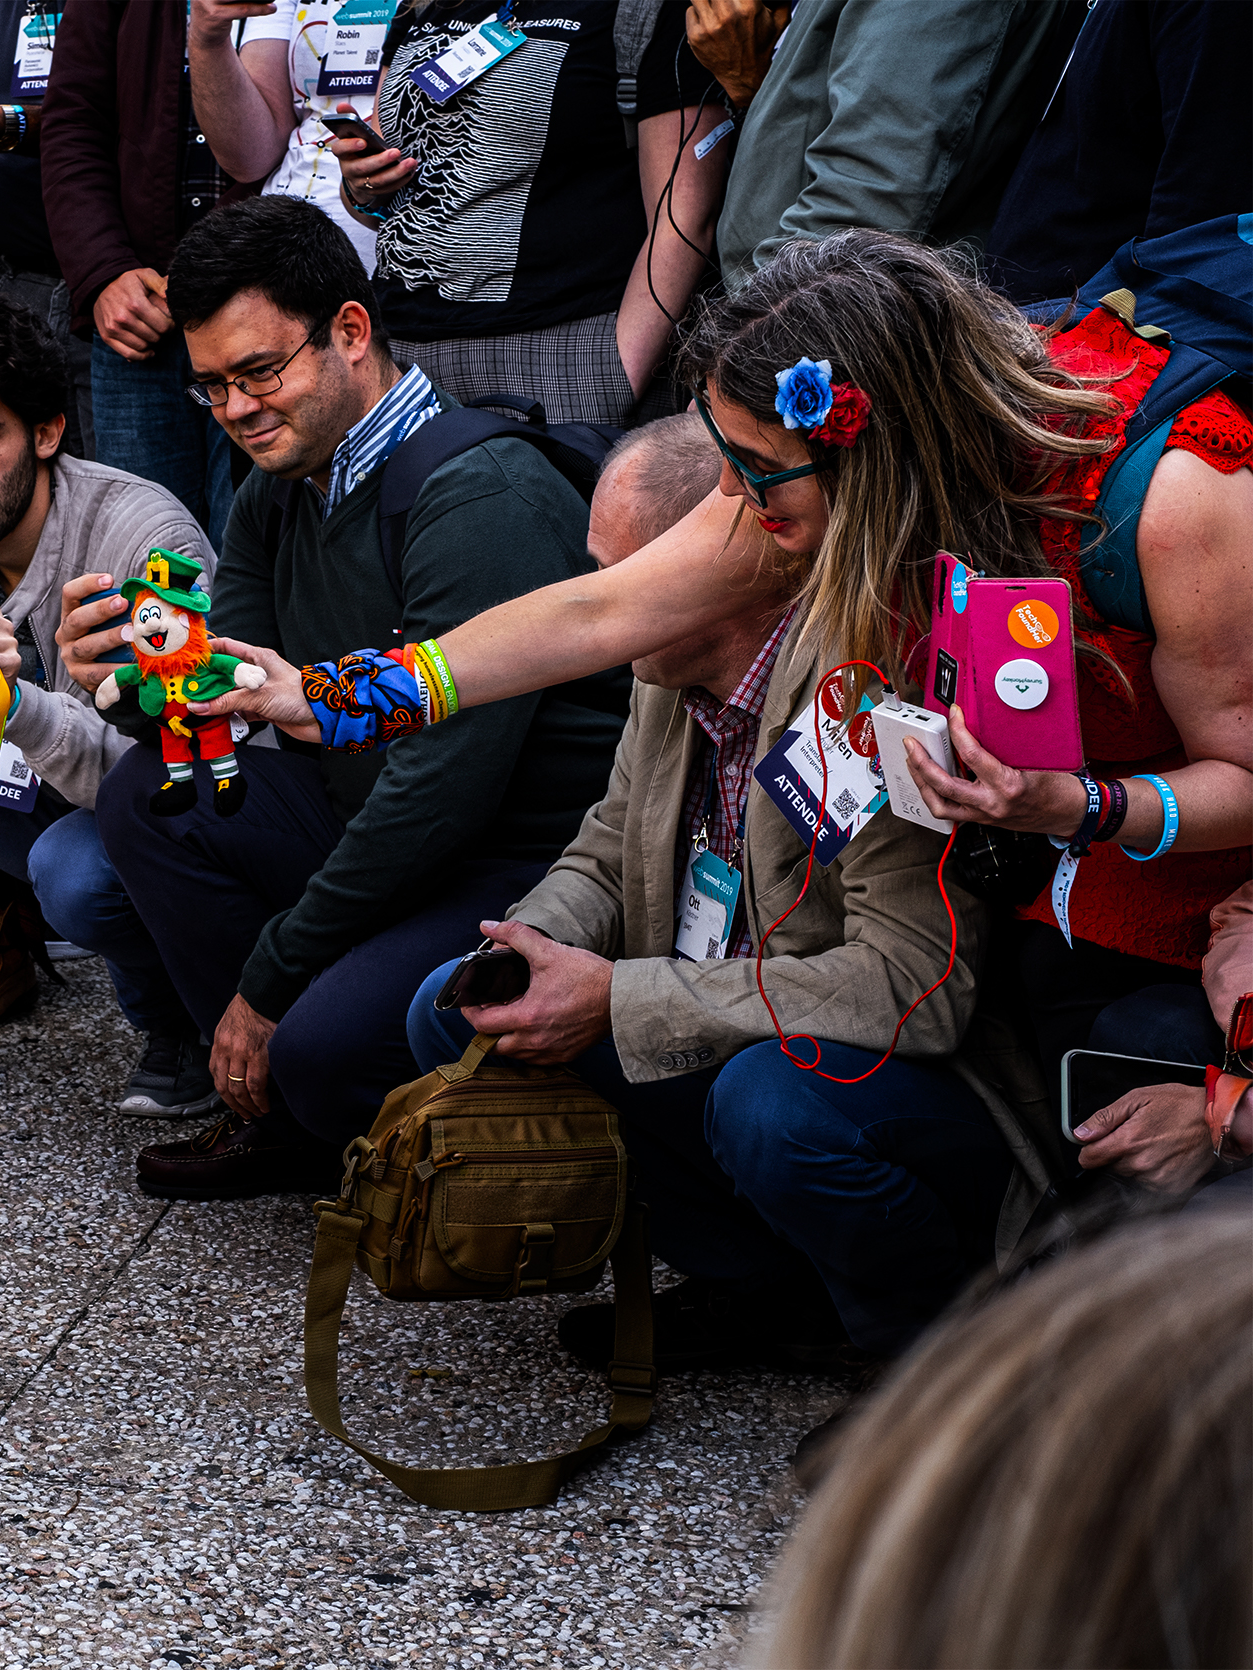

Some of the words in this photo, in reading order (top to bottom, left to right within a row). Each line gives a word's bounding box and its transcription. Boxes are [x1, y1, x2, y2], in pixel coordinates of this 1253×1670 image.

[373, 9, 389, 18] 2019
[336, 29, 360, 40] Robin
[467, 37, 488, 57] Lorraine
[20, 80, 48, 90] ATTEN
[328, 75, 374, 87] ATTENDEE
[422, 69, 450, 93] ATTENDEE
[1022, 603, 1037, 624] Tech
[1014, 607, 1042, 642] FoundHer
[433, 656, 450, 689] DESIGN.
[1001, 676, 1042, 684] SurveyMonkey
[1080, 776, 1100, 813] NDEE
[720, 879, 734, 896] 2019
[688, 894, 701, 912] Ott
